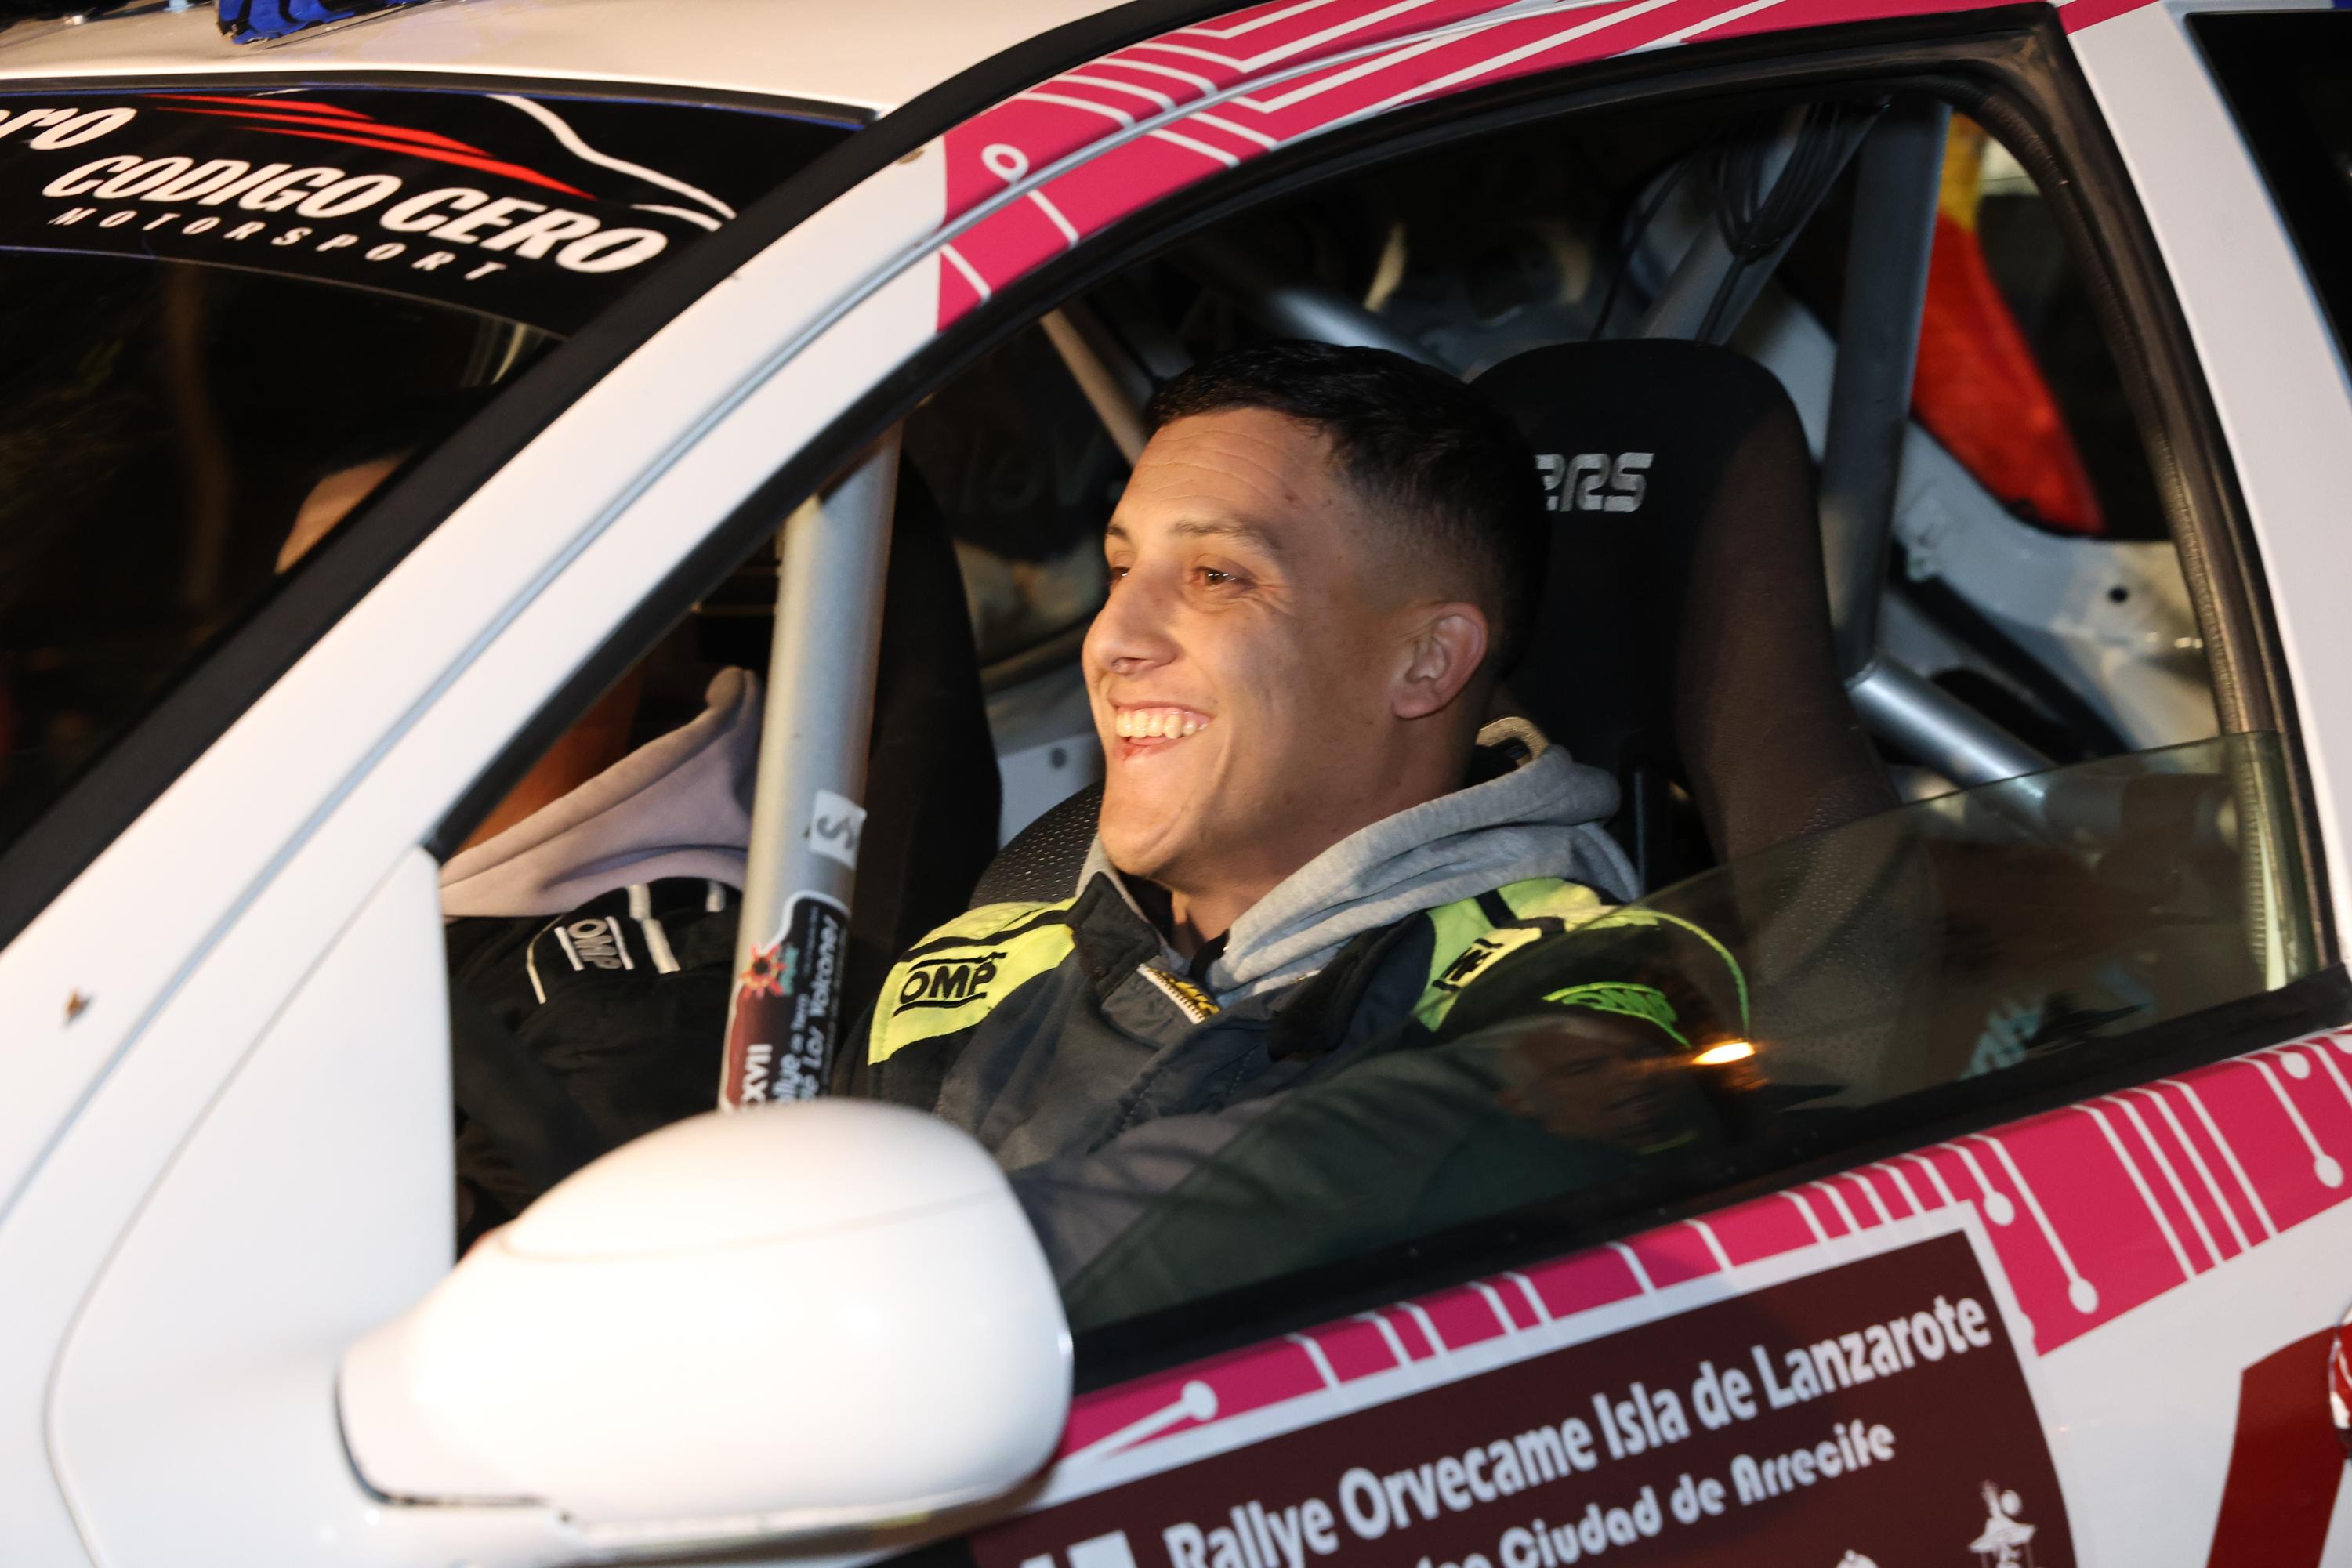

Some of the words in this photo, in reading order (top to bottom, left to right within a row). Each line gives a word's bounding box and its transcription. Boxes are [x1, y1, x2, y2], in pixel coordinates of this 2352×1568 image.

[42, 155, 403, 219] CODIGO
[379, 187, 668, 273] CERO
[48, 206, 508, 281] MOTORSPORT
[900, 961, 997, 1004] OMP
[1162, 1499, 1339, 1568] Rallye
[1339, 1416, 1598, 1540] Orvecame
[1592, 1382, 1691, 1461] Isla
[1692, 1361, 1757, 1430] de
[1751, 1295, 1991, 1410] Lanzarote
[1499, 1487, 1662, 1568] Ciudad
[1670, 1473, 1725, 1524] de
[1730, 1419, 1895, 1505] Arrecife
